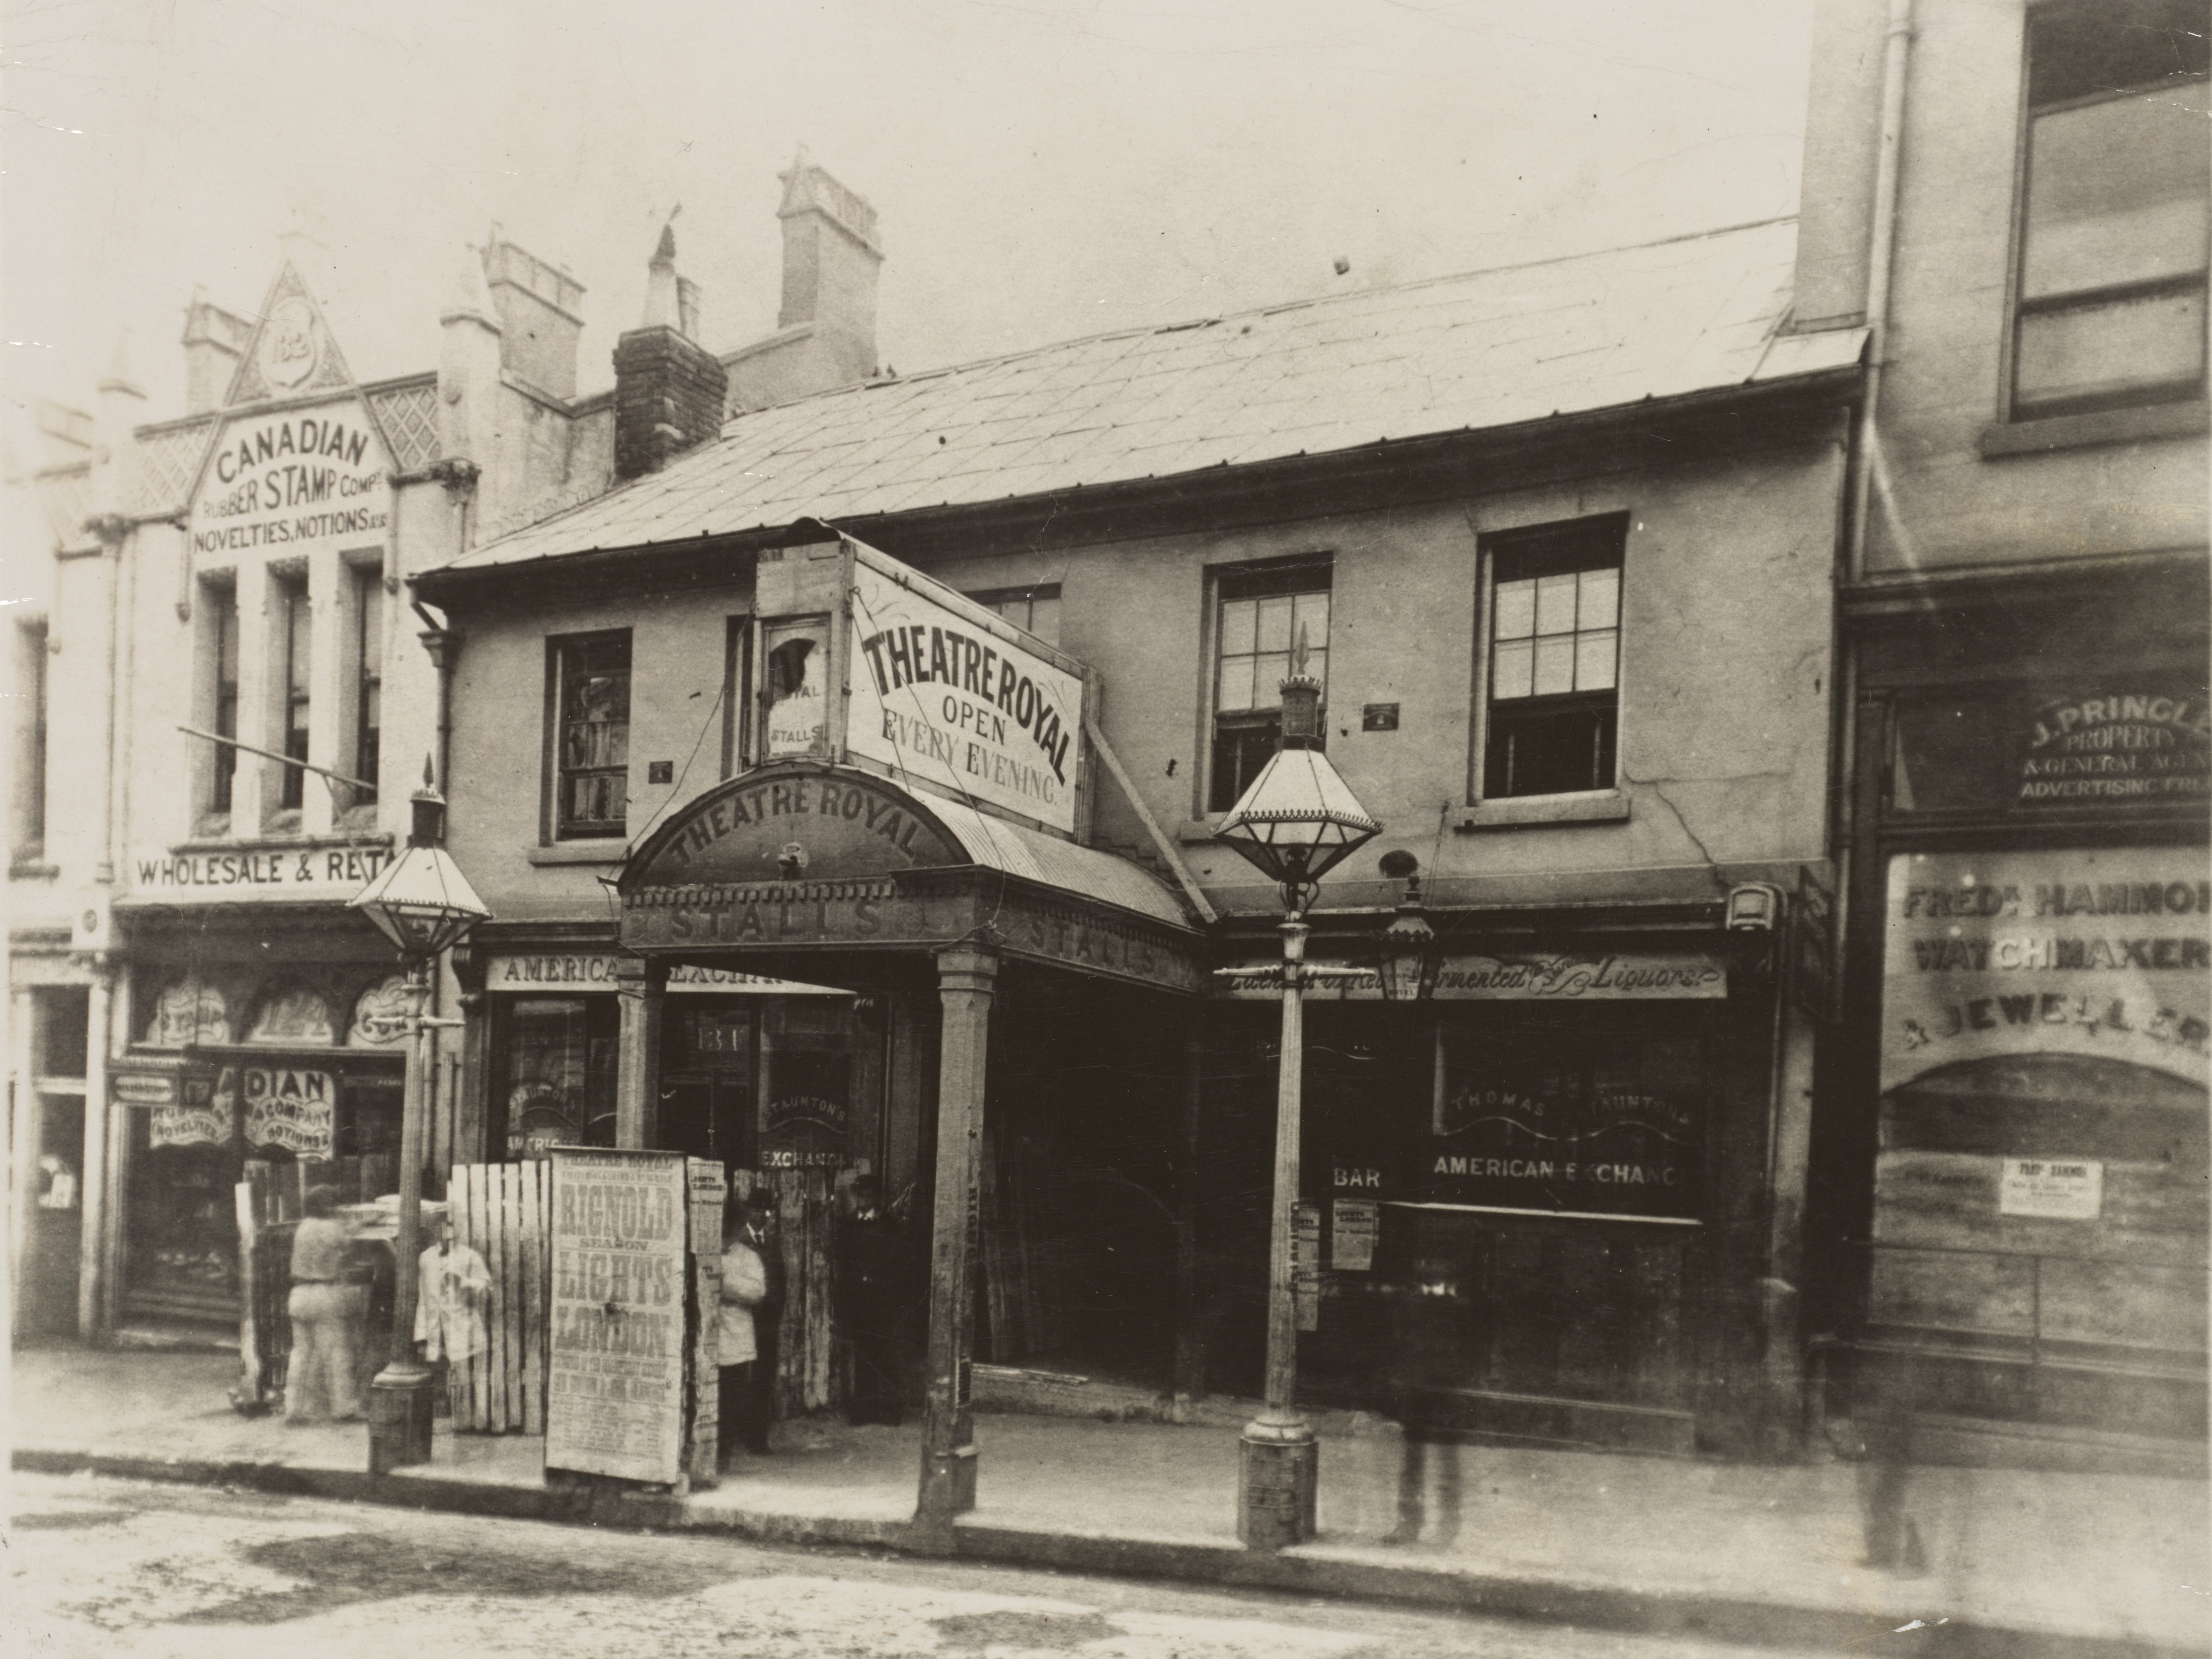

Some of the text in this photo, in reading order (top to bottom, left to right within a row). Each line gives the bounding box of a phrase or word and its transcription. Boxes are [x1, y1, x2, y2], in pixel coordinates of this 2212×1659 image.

[217, 419, 368, 483] CANADIAN
[203, 479, 258, 519] RUBBER
[264, 465, 336, 509] STAMP
[295, 507, 368, 541] NOTIONS
[863, 626, 1070, 787] THEATRE ROYAL
[942, 696, 1006, 746] OPEN
[771, 725, 823, 742] STALLS
[881, 707, 959, 766] EVERY
[666, 782, 919, 865] THEATRE ROYAL
[138, 854, 284, 885] WHOLESALE
[295, 853, 314, 882] &
[670, 900, 882, 939] STALLS
[1028, 918, 1155, 975] STALLS
[1913, 937, 2211, 971] WATCHMAKER
[504, 956, 618, 982] AMERICA
[1451, 1091, 1545, 1117] THOMAS
[1334, 1168, 1381, 1187] BAR
[1433, 1156, 1554, 1179] AMERICAN
[559, 1183, 672, 1241] RIGNOLD
[579, 1238, 649, 1251] SEASON
[558, 1251, 673, 1307] LIGHTS
[555, 1305, 670, 1358] LONDON
